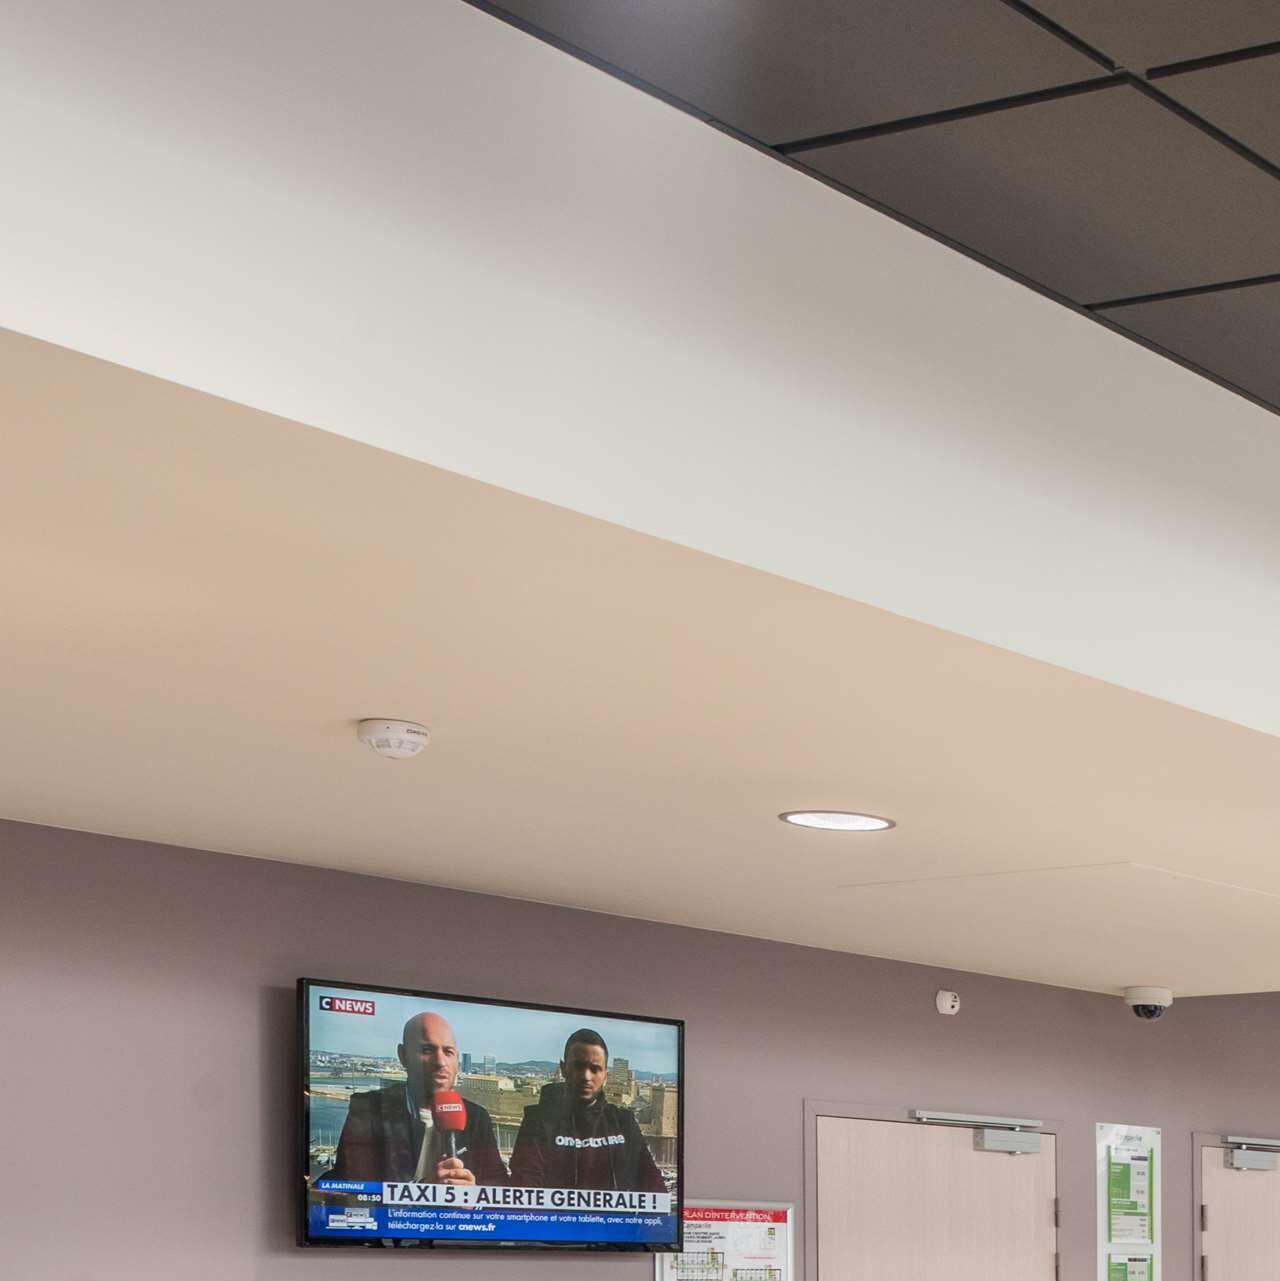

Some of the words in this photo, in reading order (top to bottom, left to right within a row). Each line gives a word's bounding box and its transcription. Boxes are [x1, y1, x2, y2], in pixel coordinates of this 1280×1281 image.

[335, 1001, 373, 1013] NEWS
[331, 1183, 365, 1191] MATINALE
[387, 1184, 437, 1203] TAXI
[444, 1186, 456, 1204] 5
[476, 1188, 545, 1206] ALERTE
[551, 1190, 646, 1210] GENERALE
[388, 1208, 437, 1219] L'information
[439, 1210, 471, 1219] continue
[486, 1213, 505, 1221] votre
[507, 1213, 548, 1223] smartphone
[625, 1216, 643, 1224] notre
[458, 1223, 496, 1231] cnews.fr
